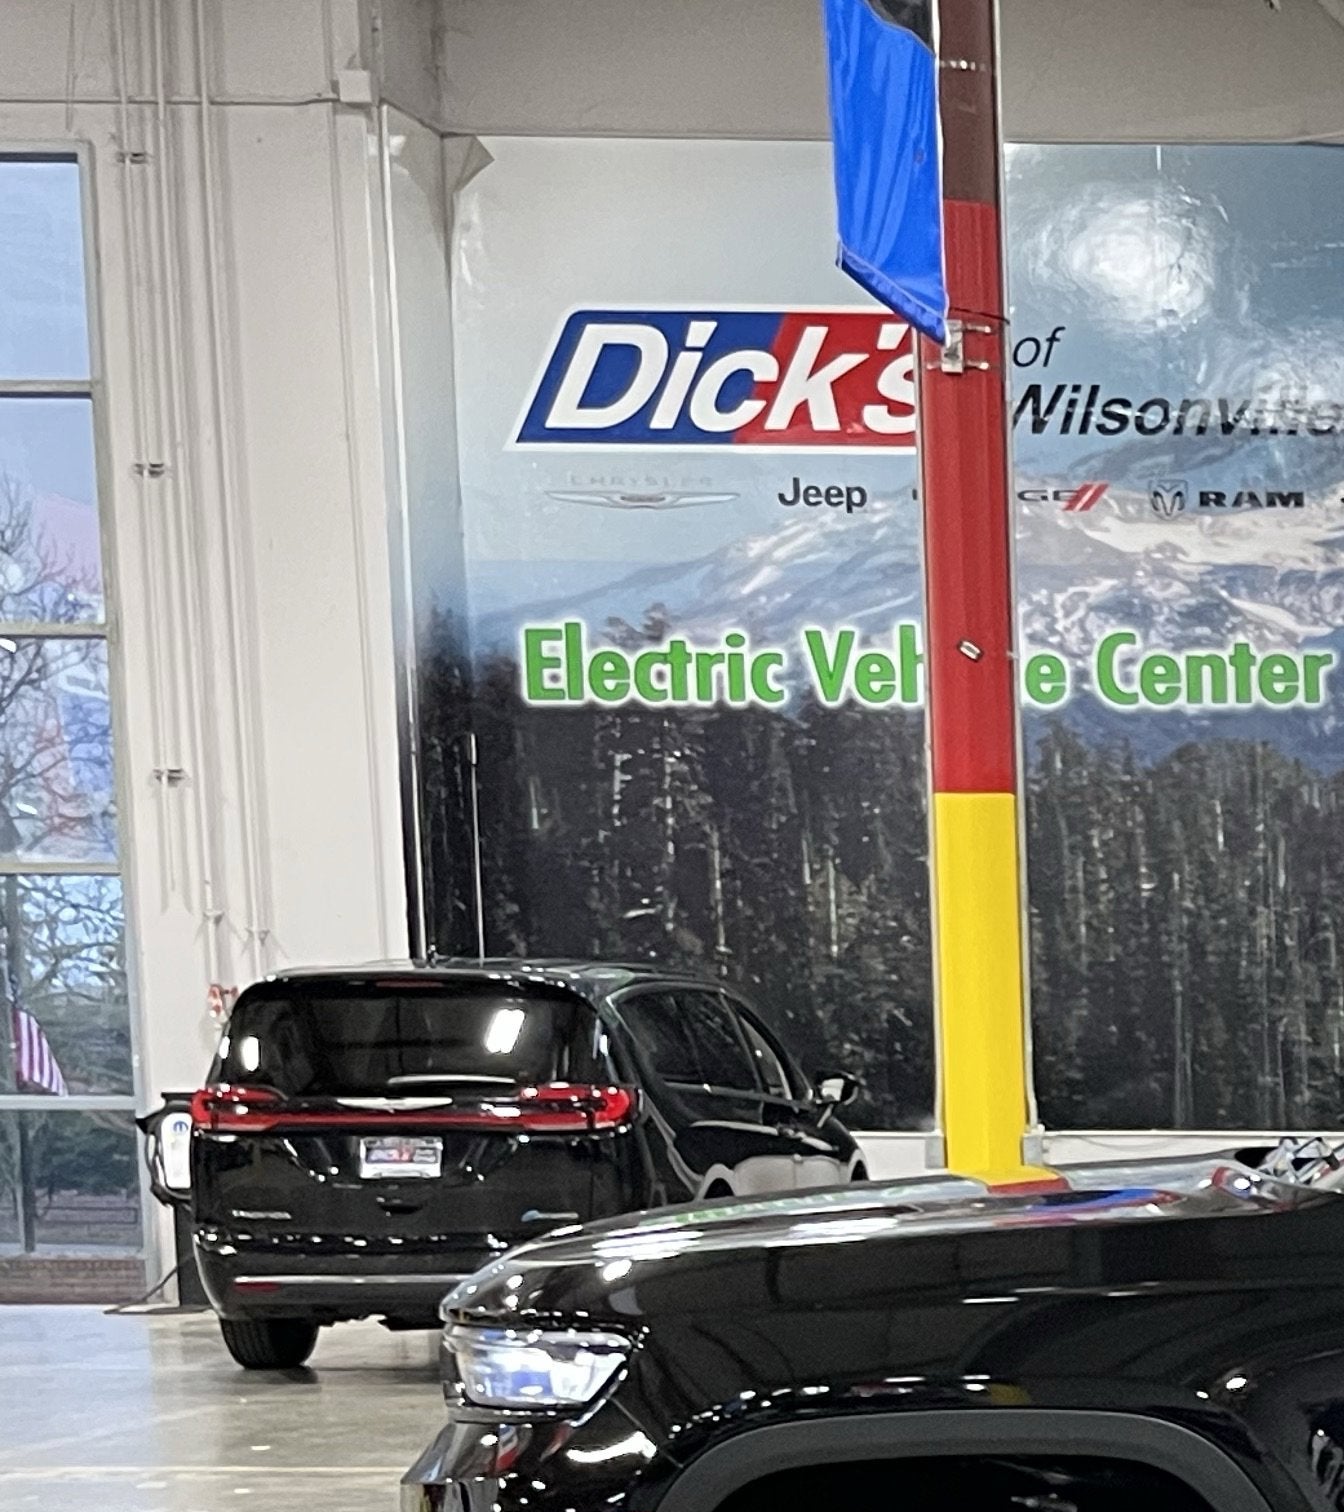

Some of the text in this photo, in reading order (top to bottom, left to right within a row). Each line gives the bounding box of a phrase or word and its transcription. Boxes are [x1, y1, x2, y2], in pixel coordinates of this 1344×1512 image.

[1012, 326, 1066, 368] of
[544, 320, 918, 434] Dick's
[777, 477, 868, 514] Jeep
[1199, 490, 1305, 508] RAM
[524, 622, 1333, 705] Electric Vehe Center
